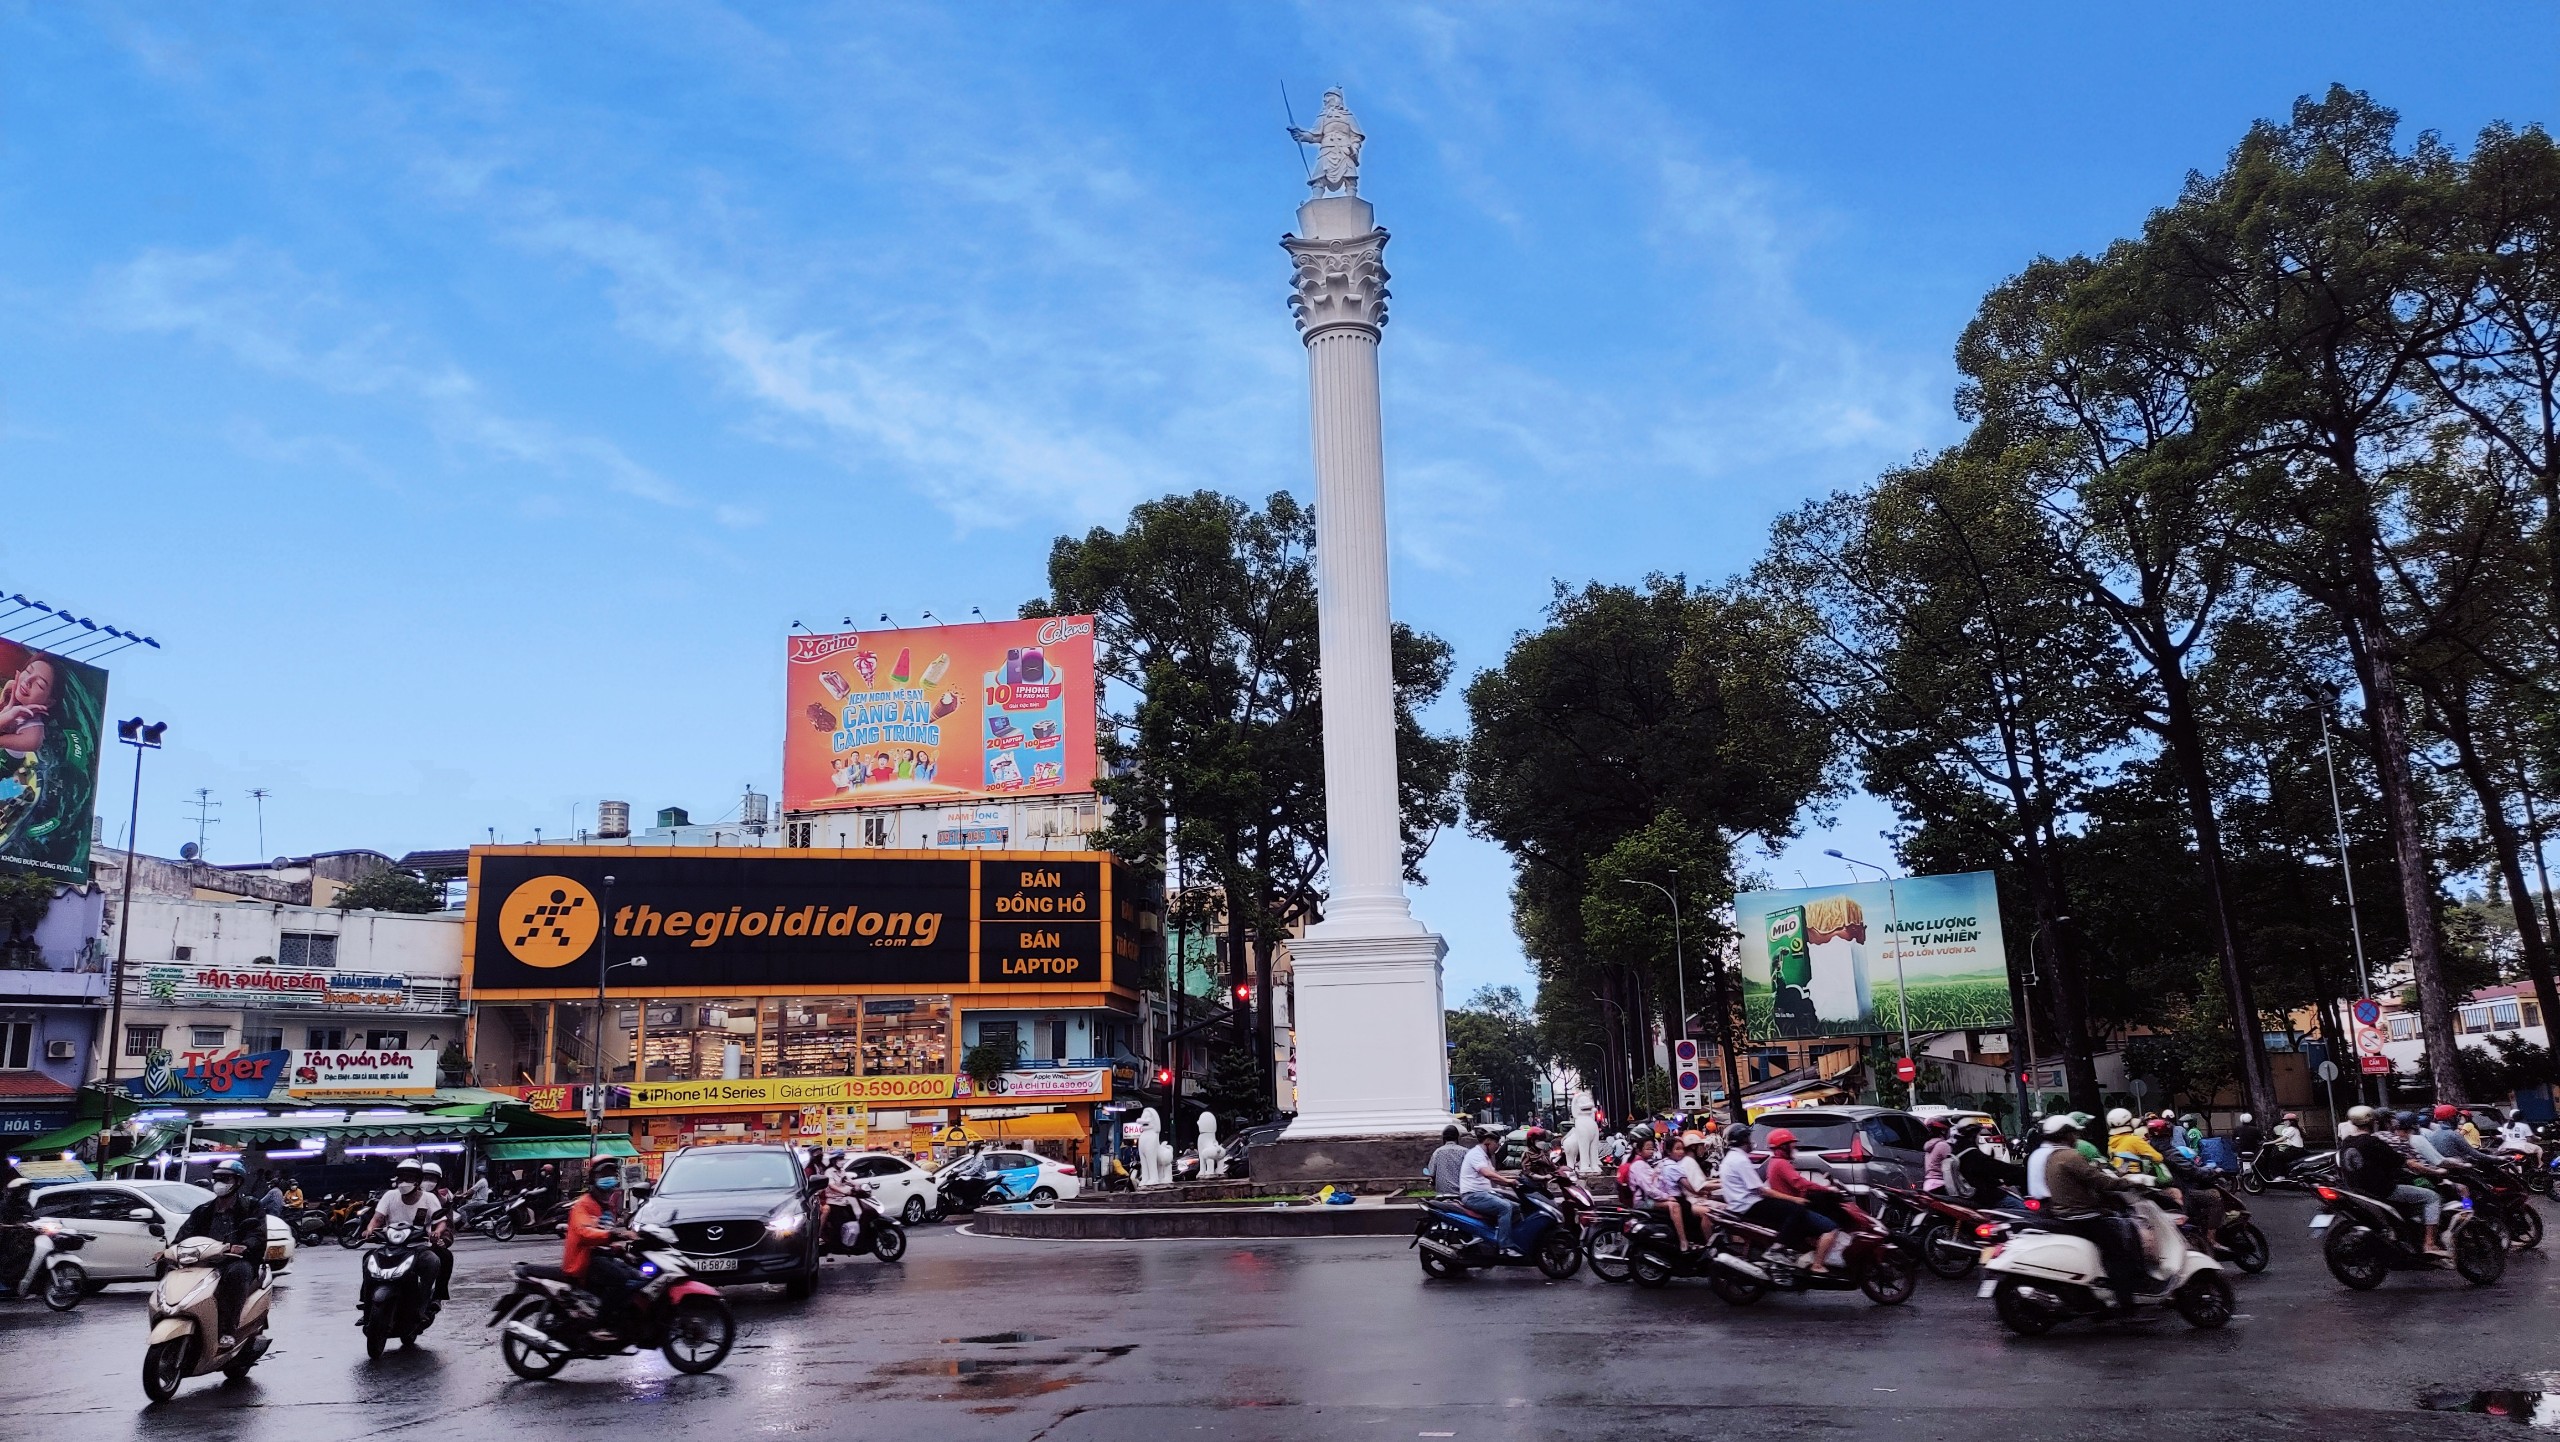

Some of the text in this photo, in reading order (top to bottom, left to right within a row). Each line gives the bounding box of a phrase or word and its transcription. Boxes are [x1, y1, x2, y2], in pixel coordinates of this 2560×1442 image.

[1038, 619, 1090, 645] Celano
[798, 634, 858, 658] Merino
[849, 688, 924, 705] KEM NGON MÊ SAY
[986, 685, 1010, 706] 10
[1016, 686, 1050, 694] IPHONE
[843, 700, 930, 729] CÀNG ĂN
[833, 722, 940, 752] CÀNG TRÚNG
[986, 738, 1000, 749] 20
[1002, 735, 1023, 744] LAPTOP
[1024, 739, 1039, 748] 100
[985, 782, 1006, 792] 2000
[947, 813, 969, 821] NAM
[1, 855, 22, 864] KHÔNG
[1020, 868, 1061, 888] BÁN
[996, 890, 1086, 913] ĐỒNG HỒ
[613, 905, 943, 948] thegioididong
[1772, 920, 1797, 937] MILO
[1884, 916, 1977, 934] NĂNG LƯỢNG
[869, 938, 907, 947] .com
[1020, 929, 1060, 949] BÁN
[1911, 933, 1931, 948] TỰ
[1916, 948, 1934, 957] LỚN
[1002, 958, 1079, 974] LAPTOP
[180, 1049, 271, 1092] Tiger
[650, 1088, 700, 1102] iPhone
[703, 1087, 719, 1100] 14
[722, 1086, 766, 1099] Series
[780, 1084, 803, 1098] Giá
[844, 1079, 945, 1097] 19.590.000
[1009, 1081, 1024, 1090] GIÁ
[1052, 1081, 1094, 1089] 6.490.000
[3, 1118, 42, 1131] HÓA 5
[694, 1260, 737, 1271] 1G-587.98
